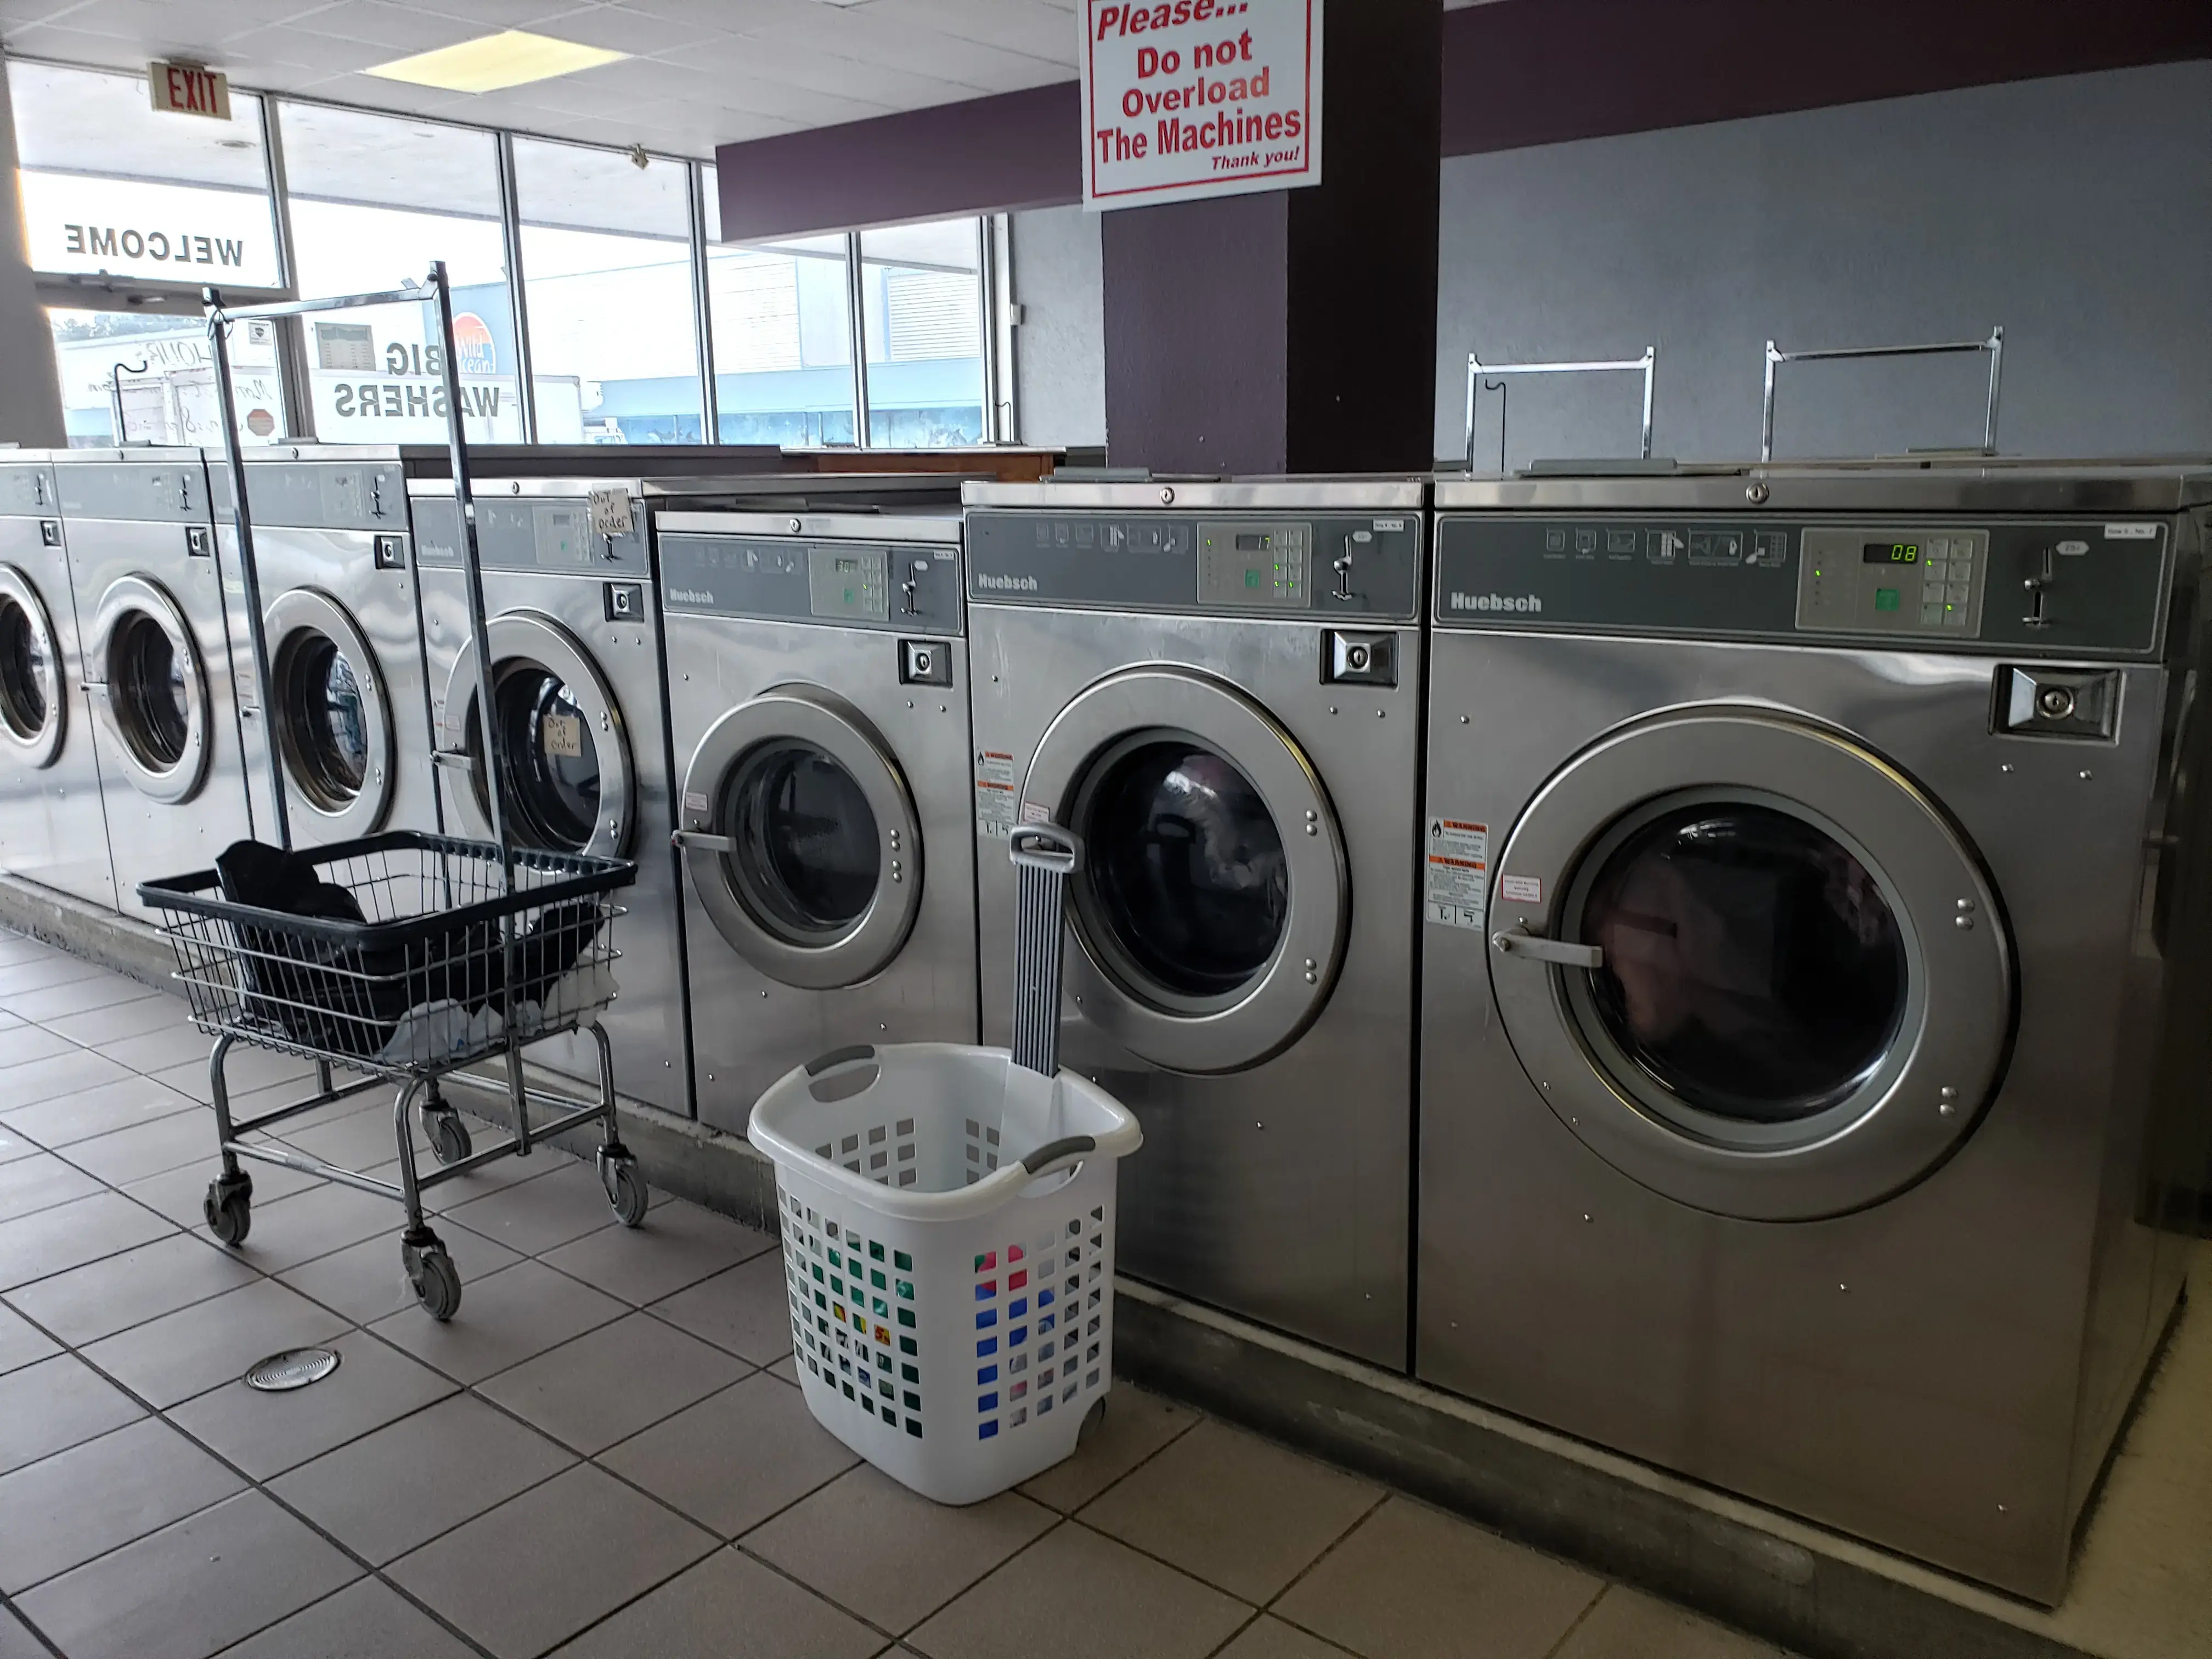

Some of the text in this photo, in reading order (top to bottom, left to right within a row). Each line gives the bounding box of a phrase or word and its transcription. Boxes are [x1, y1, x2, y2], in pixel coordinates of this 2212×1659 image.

[1137, 27, 1253, 80] Do not
[167, 67, 218, 114] EXIT
[1122, 66, 1271, 117] Overload
[1097, 109, 1301, 163] The Machines
[1211, 146, 1300, 171] Thank you!
[455, 334, 484, 358] Wild
[1891, 544, 1918, 562] 08
[978, 573, 1038, 591] Huebsch
[1451, 591, 1542, 612] Huebsch
